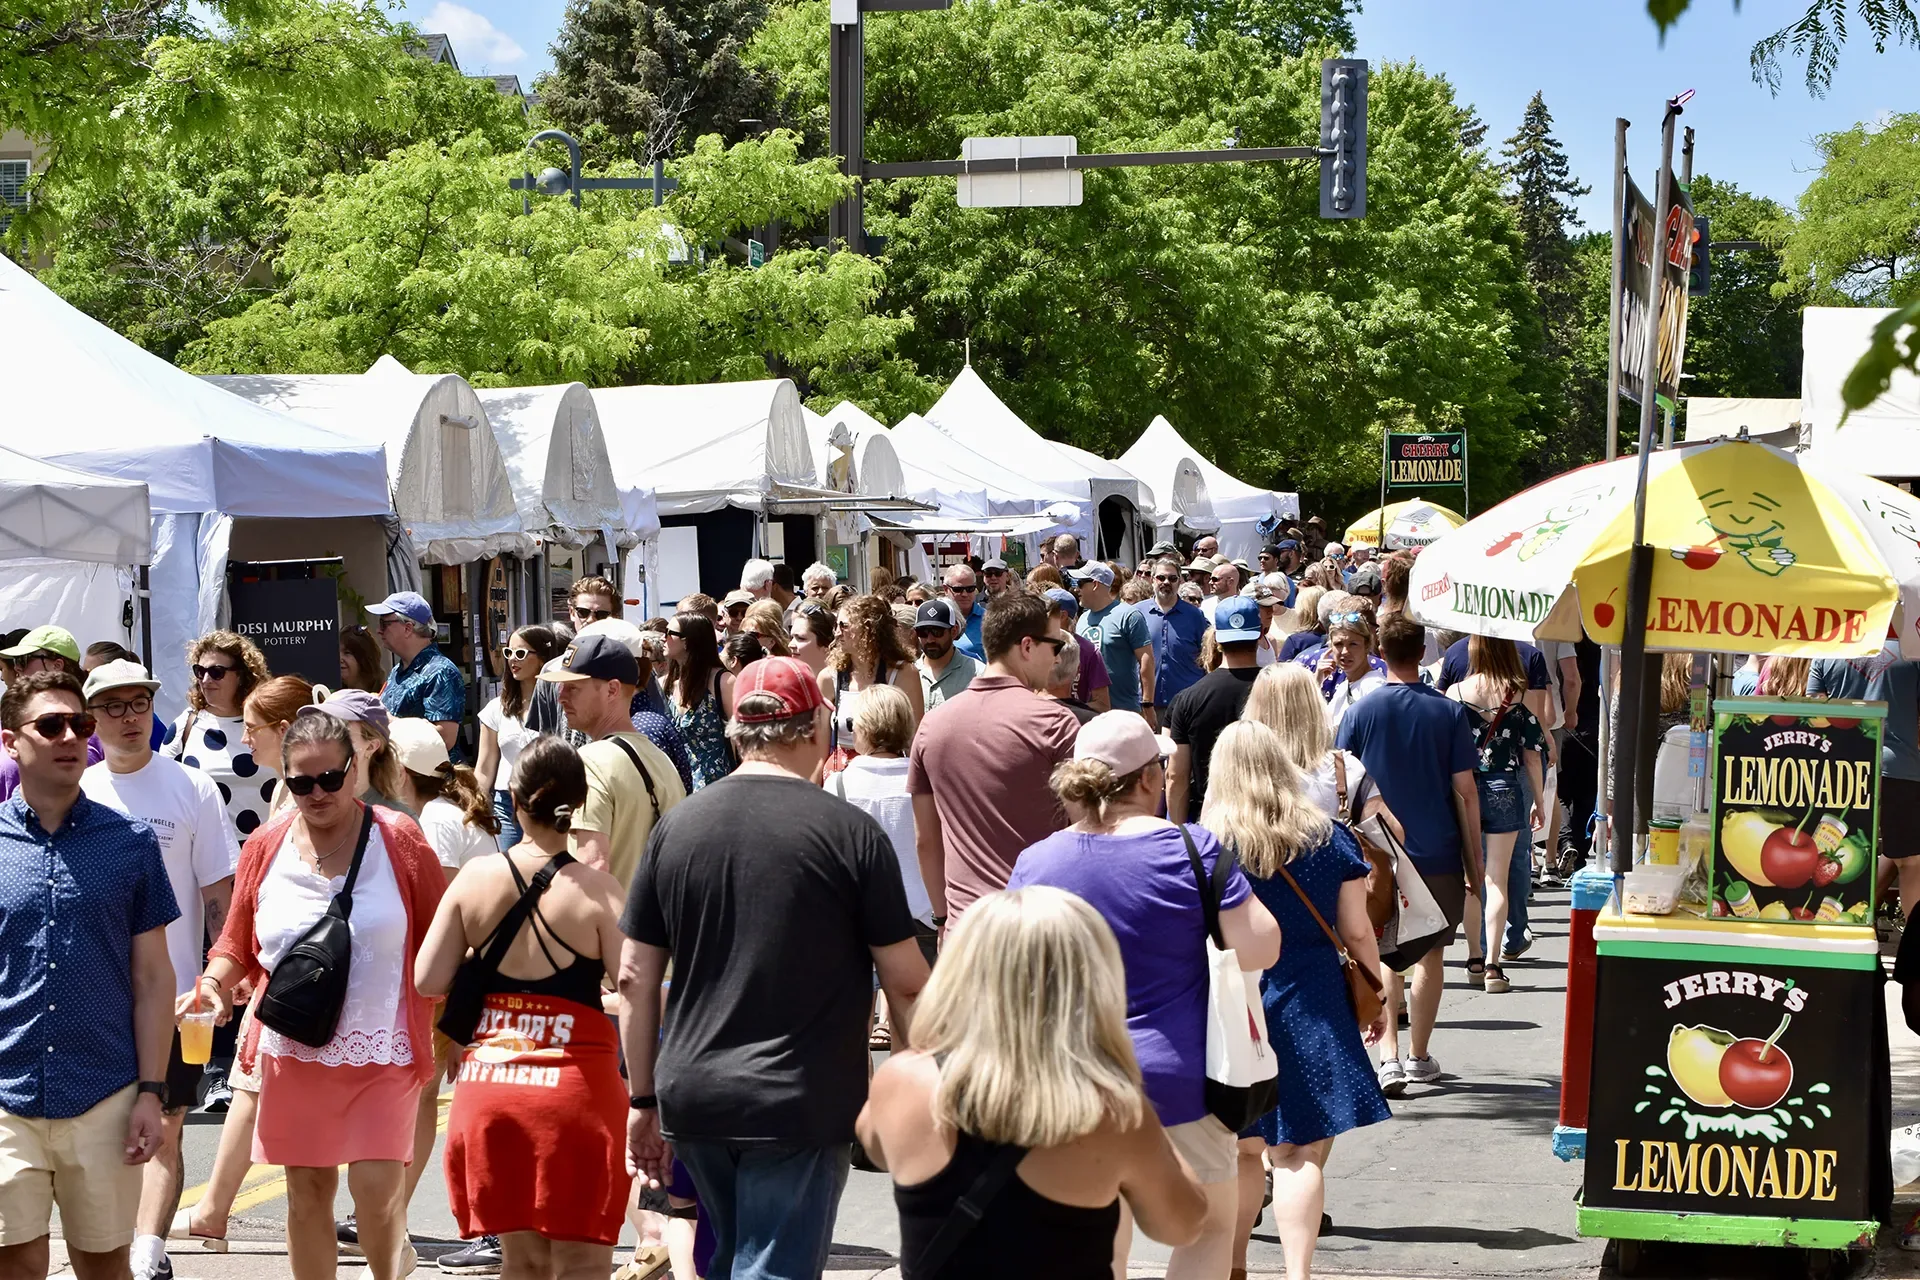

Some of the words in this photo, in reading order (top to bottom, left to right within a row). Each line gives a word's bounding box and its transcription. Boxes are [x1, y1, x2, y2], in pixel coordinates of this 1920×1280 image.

[1402, 443, 1450, 457] CHERRY
[1390, 459, 1462, 483] LEMONADE
[1403, 537, 1435, 546] LEMON
[1421, 572, 1452, 602] CHERRY
[237, 622, 267, 635] DESI
[272, 619, 334, 633] MURPHY
[264, 636, 307, 646] POTTERY
[1763, 731, 1832, 753] JERRY'S
[1722, 755, 1871, 810] LEMONADE
[149, 817, 176, 829] ANGELES
[1662, 971, 1809, 1013] JERRY'S
[475, 1007, 574, 1046] AYLOR'S
[1612, 1139, 1838, 1202] LEMONADE
